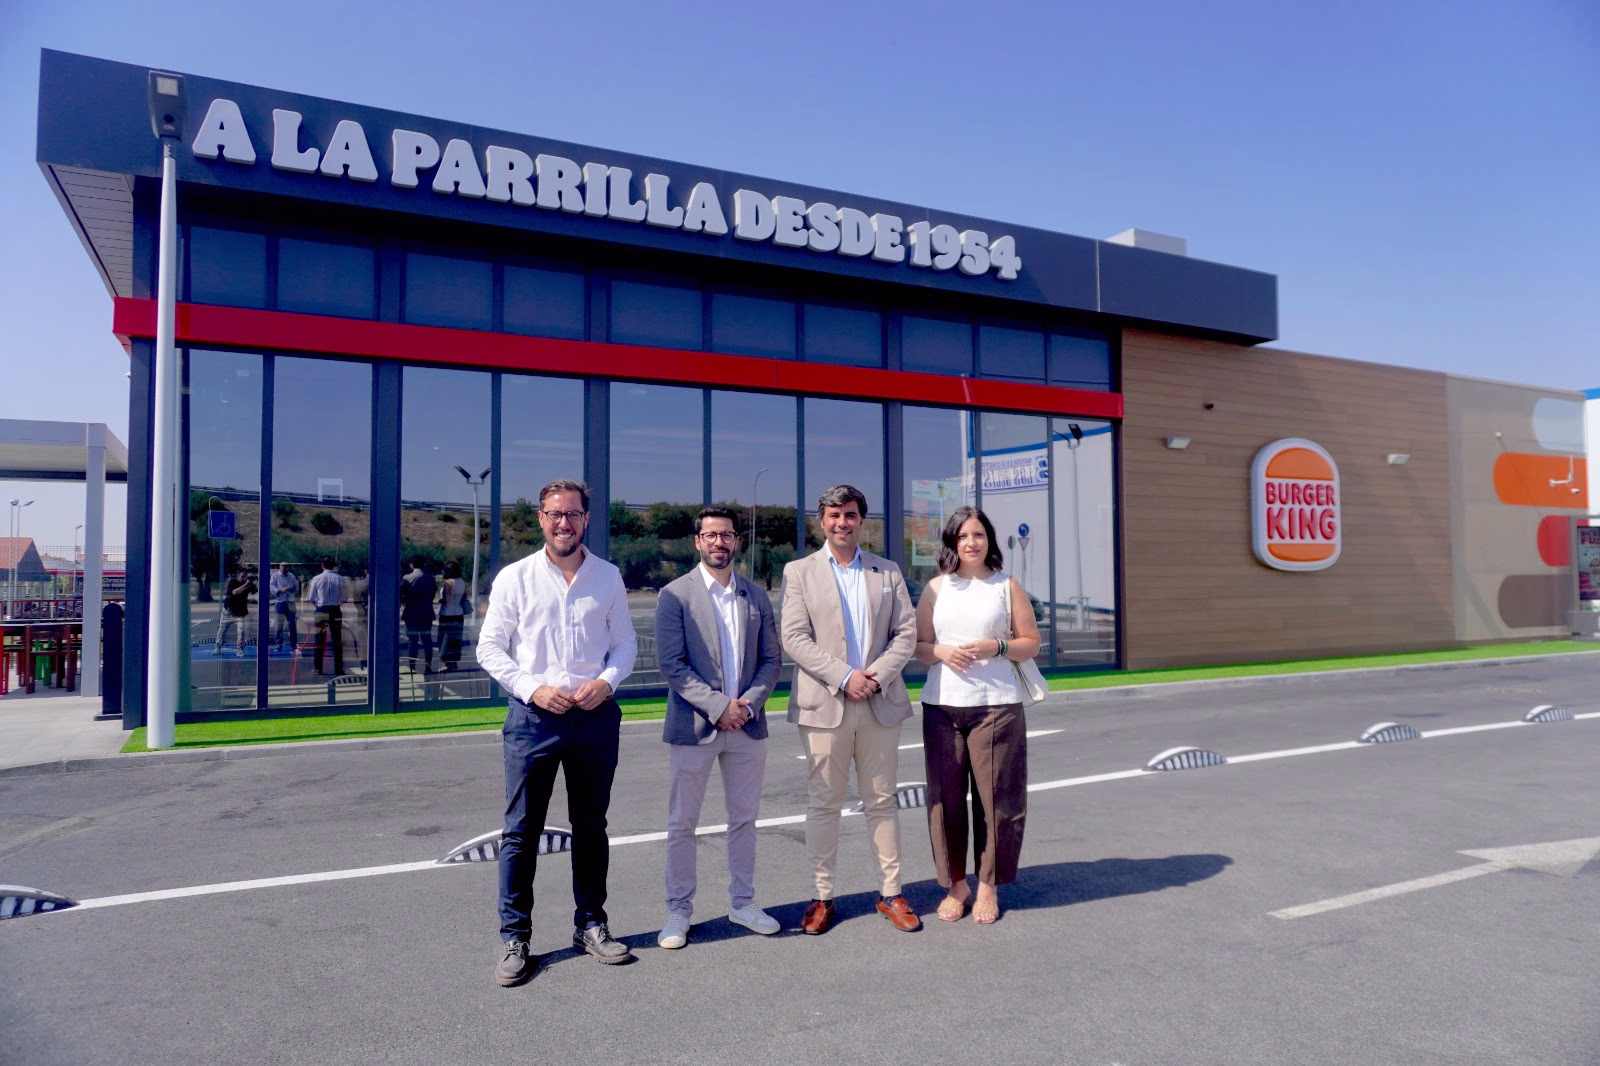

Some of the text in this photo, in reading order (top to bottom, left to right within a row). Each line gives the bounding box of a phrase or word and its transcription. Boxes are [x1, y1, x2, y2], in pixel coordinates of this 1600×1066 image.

[192, 98, 1023, 280] A LA PARRILLA DESDE 1954
[1265, 482, 1336, 506] BURGER
[1266, 507, 1336, 540] KING
